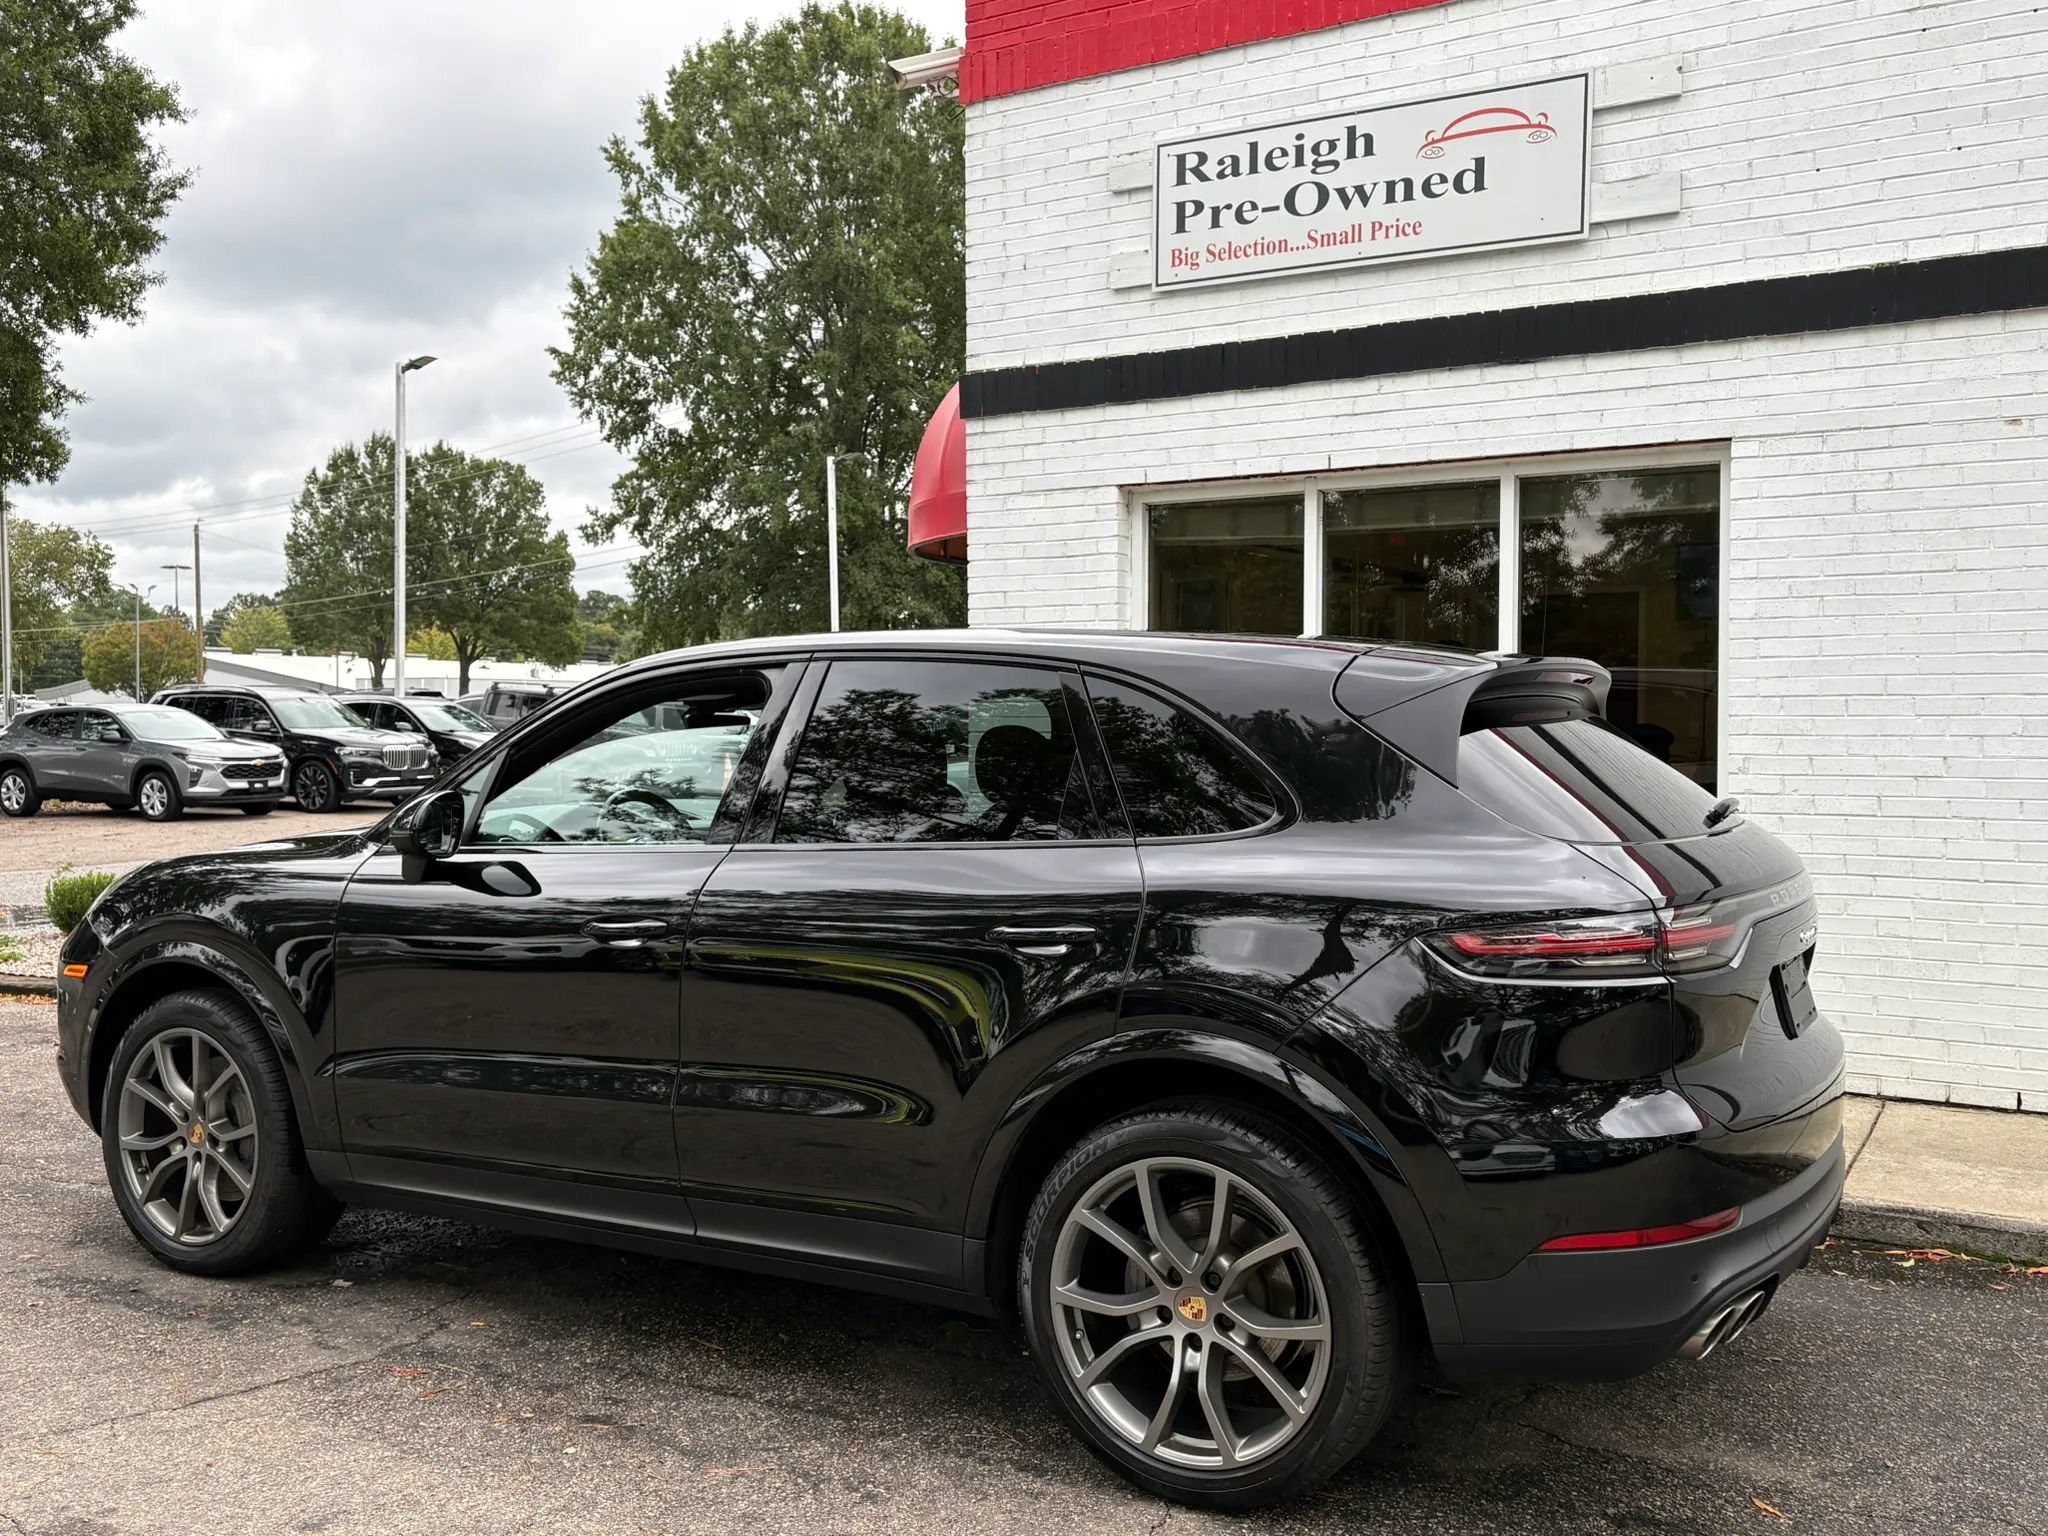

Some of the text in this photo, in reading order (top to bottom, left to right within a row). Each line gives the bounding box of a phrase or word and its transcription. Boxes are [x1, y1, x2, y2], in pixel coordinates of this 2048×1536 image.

[1171, 125, 1376, 187] Raleigh
[1171, 156, 1488, 235] Pre-Owned
[1170, 246, 1200, 270] Big
[1371, 218, 1422, 242] Price
[1024, 1136, 1109, 1263] SCORPION
